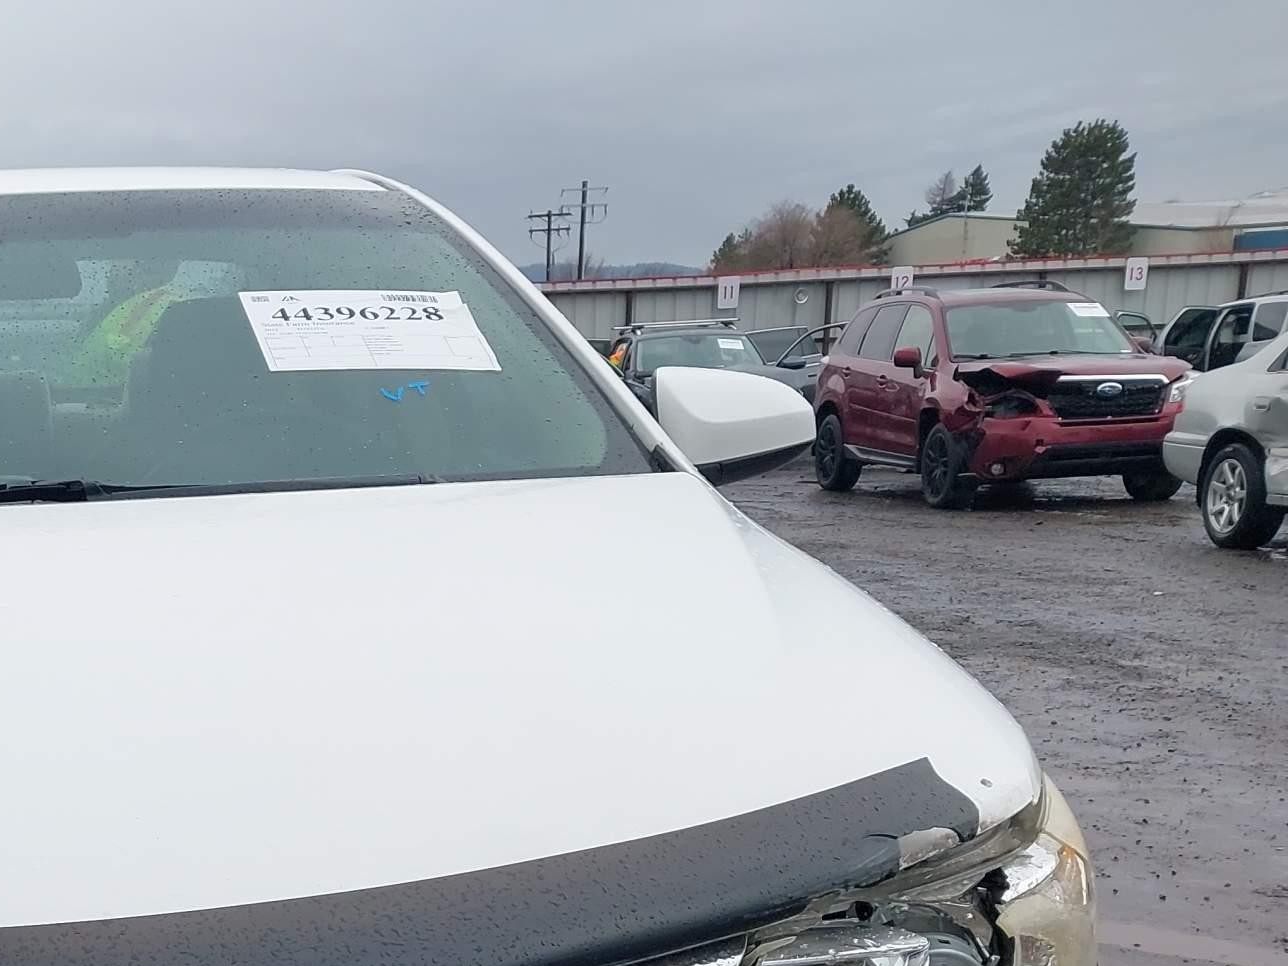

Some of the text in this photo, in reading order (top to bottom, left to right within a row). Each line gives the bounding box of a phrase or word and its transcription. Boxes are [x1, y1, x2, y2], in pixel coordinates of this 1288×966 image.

[1129, 266, 1144, 281] 13
[895, 275, 910, 289] 12
[723, 284, 734, 300] 11
[271, 305, 445, 322] 44396228
